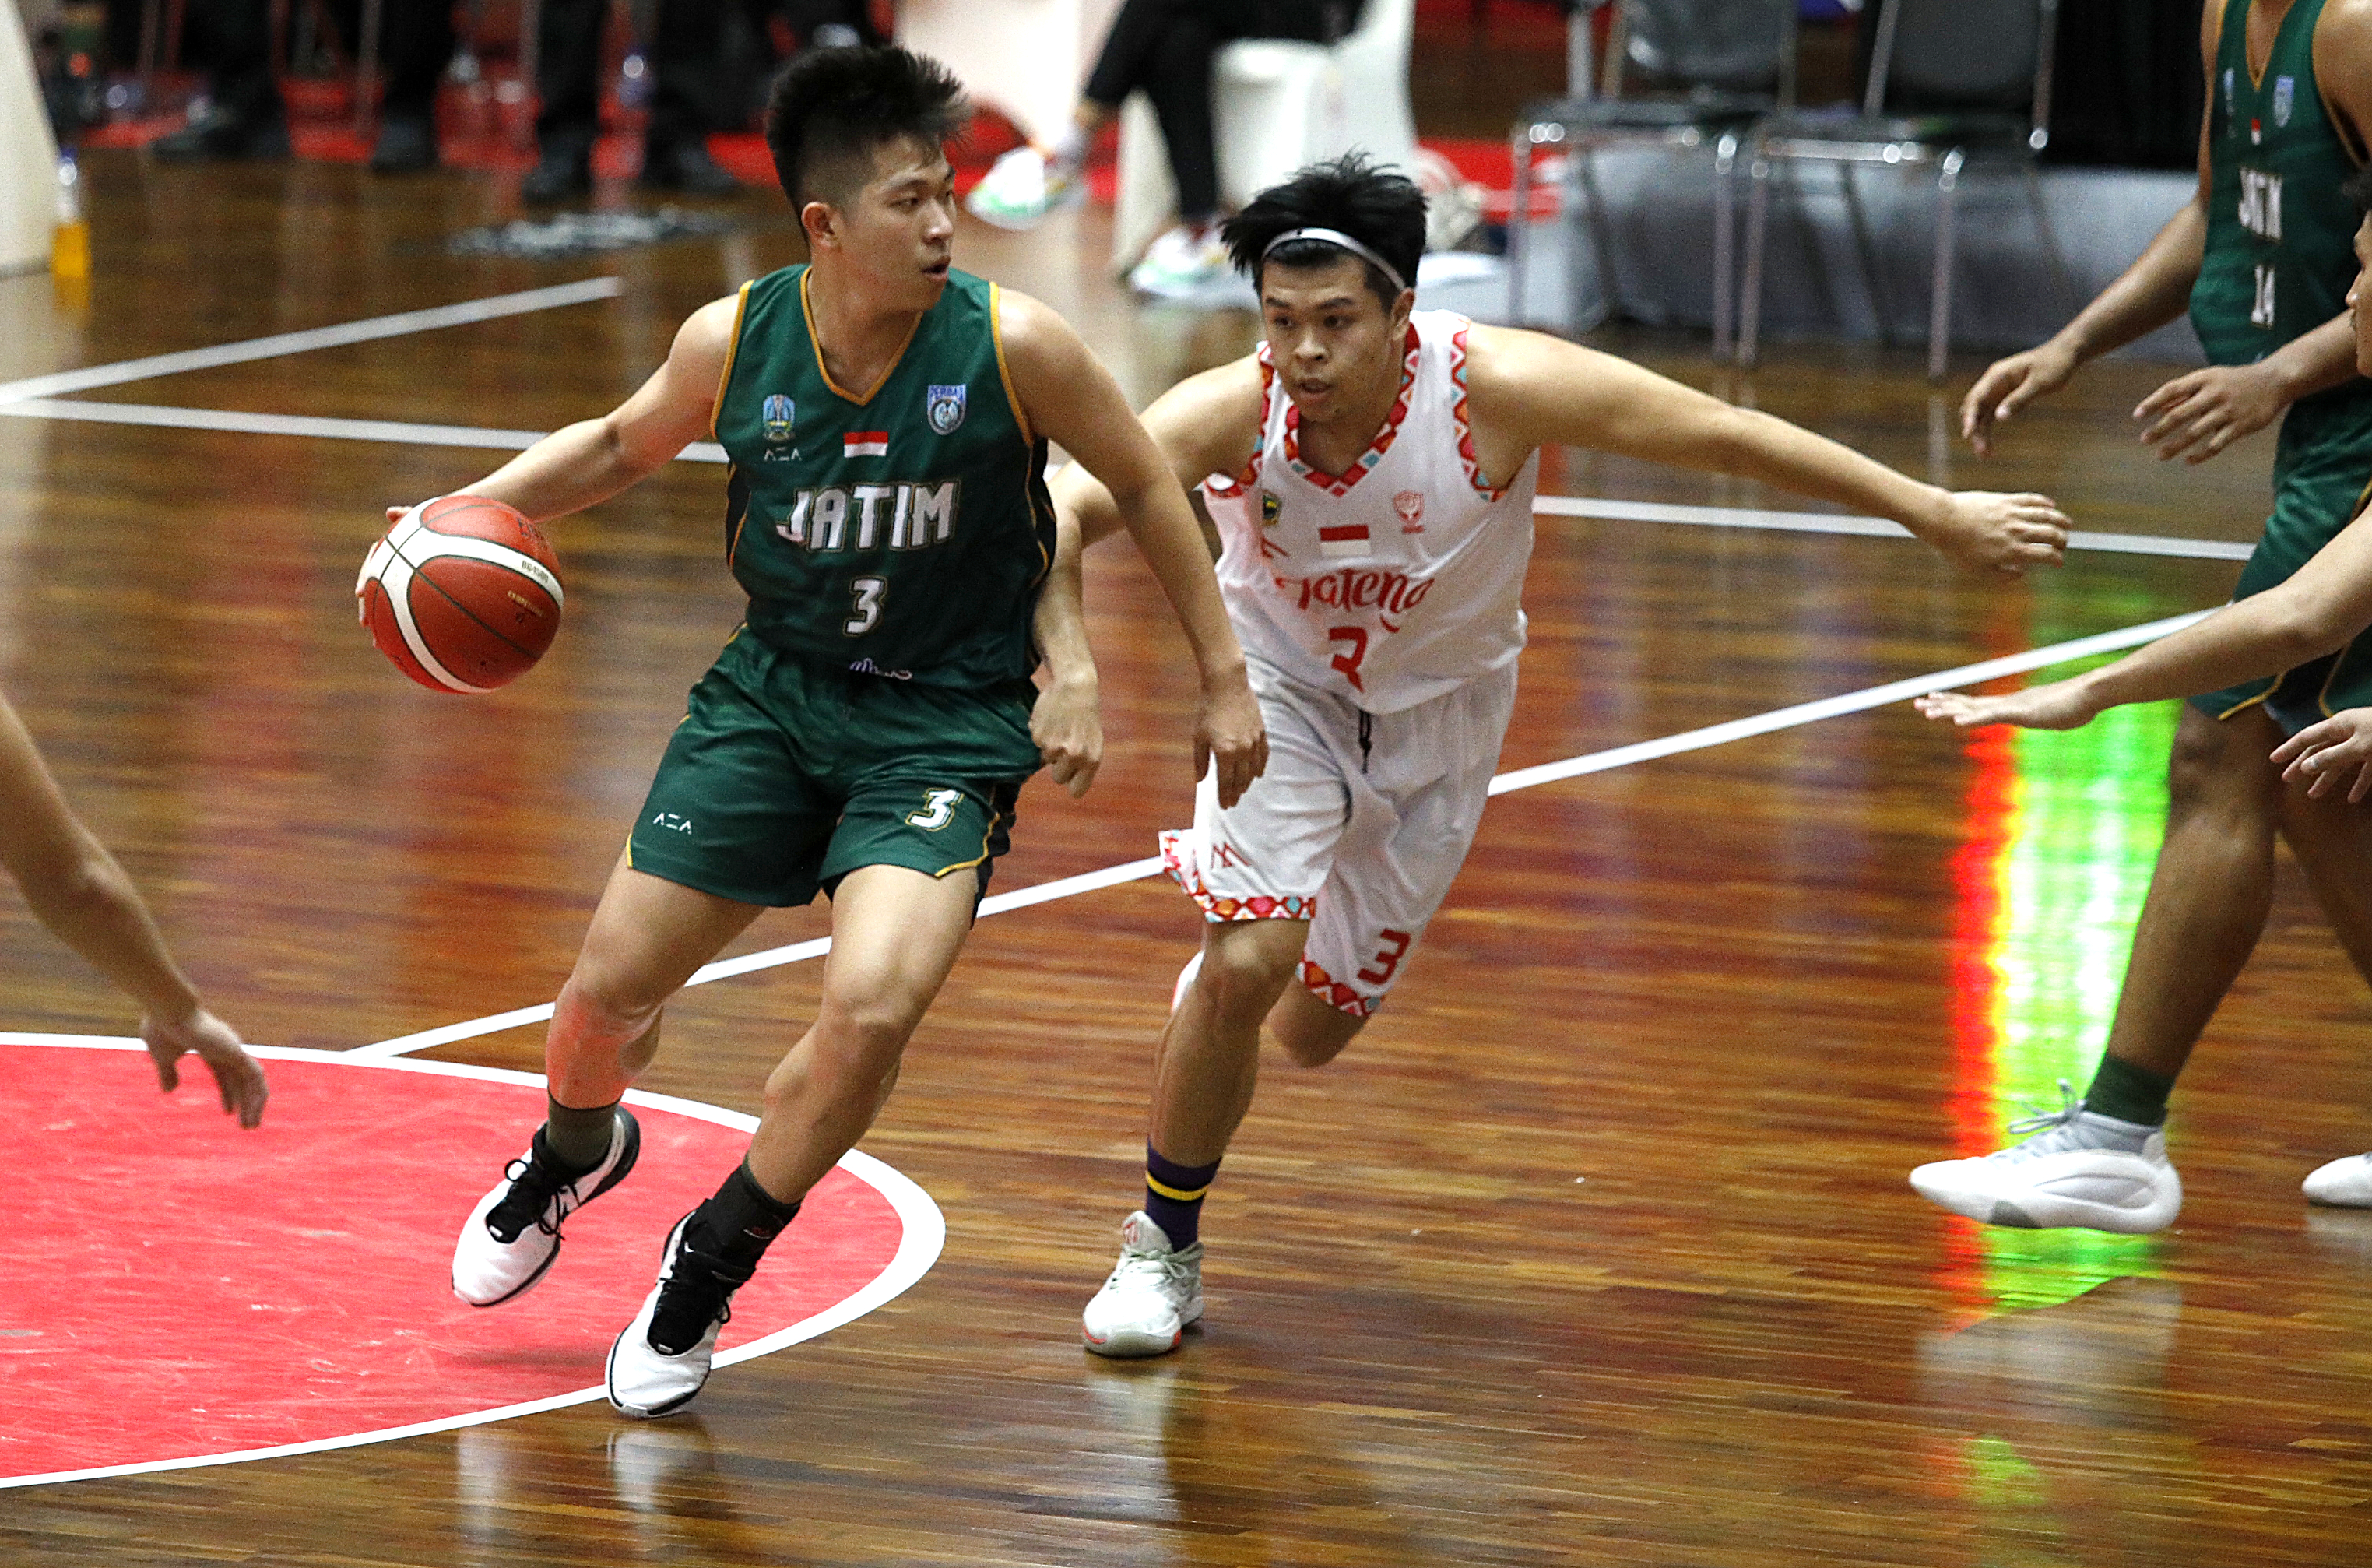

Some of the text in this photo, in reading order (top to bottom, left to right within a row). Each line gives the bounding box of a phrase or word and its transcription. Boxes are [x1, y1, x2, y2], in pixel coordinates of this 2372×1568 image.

[775, 480, 960, 550] JATIM
[845, 577, 886, 635] 3
[905, 787, 964, 832] 3
[1358, 928, 1411, 986] 3
